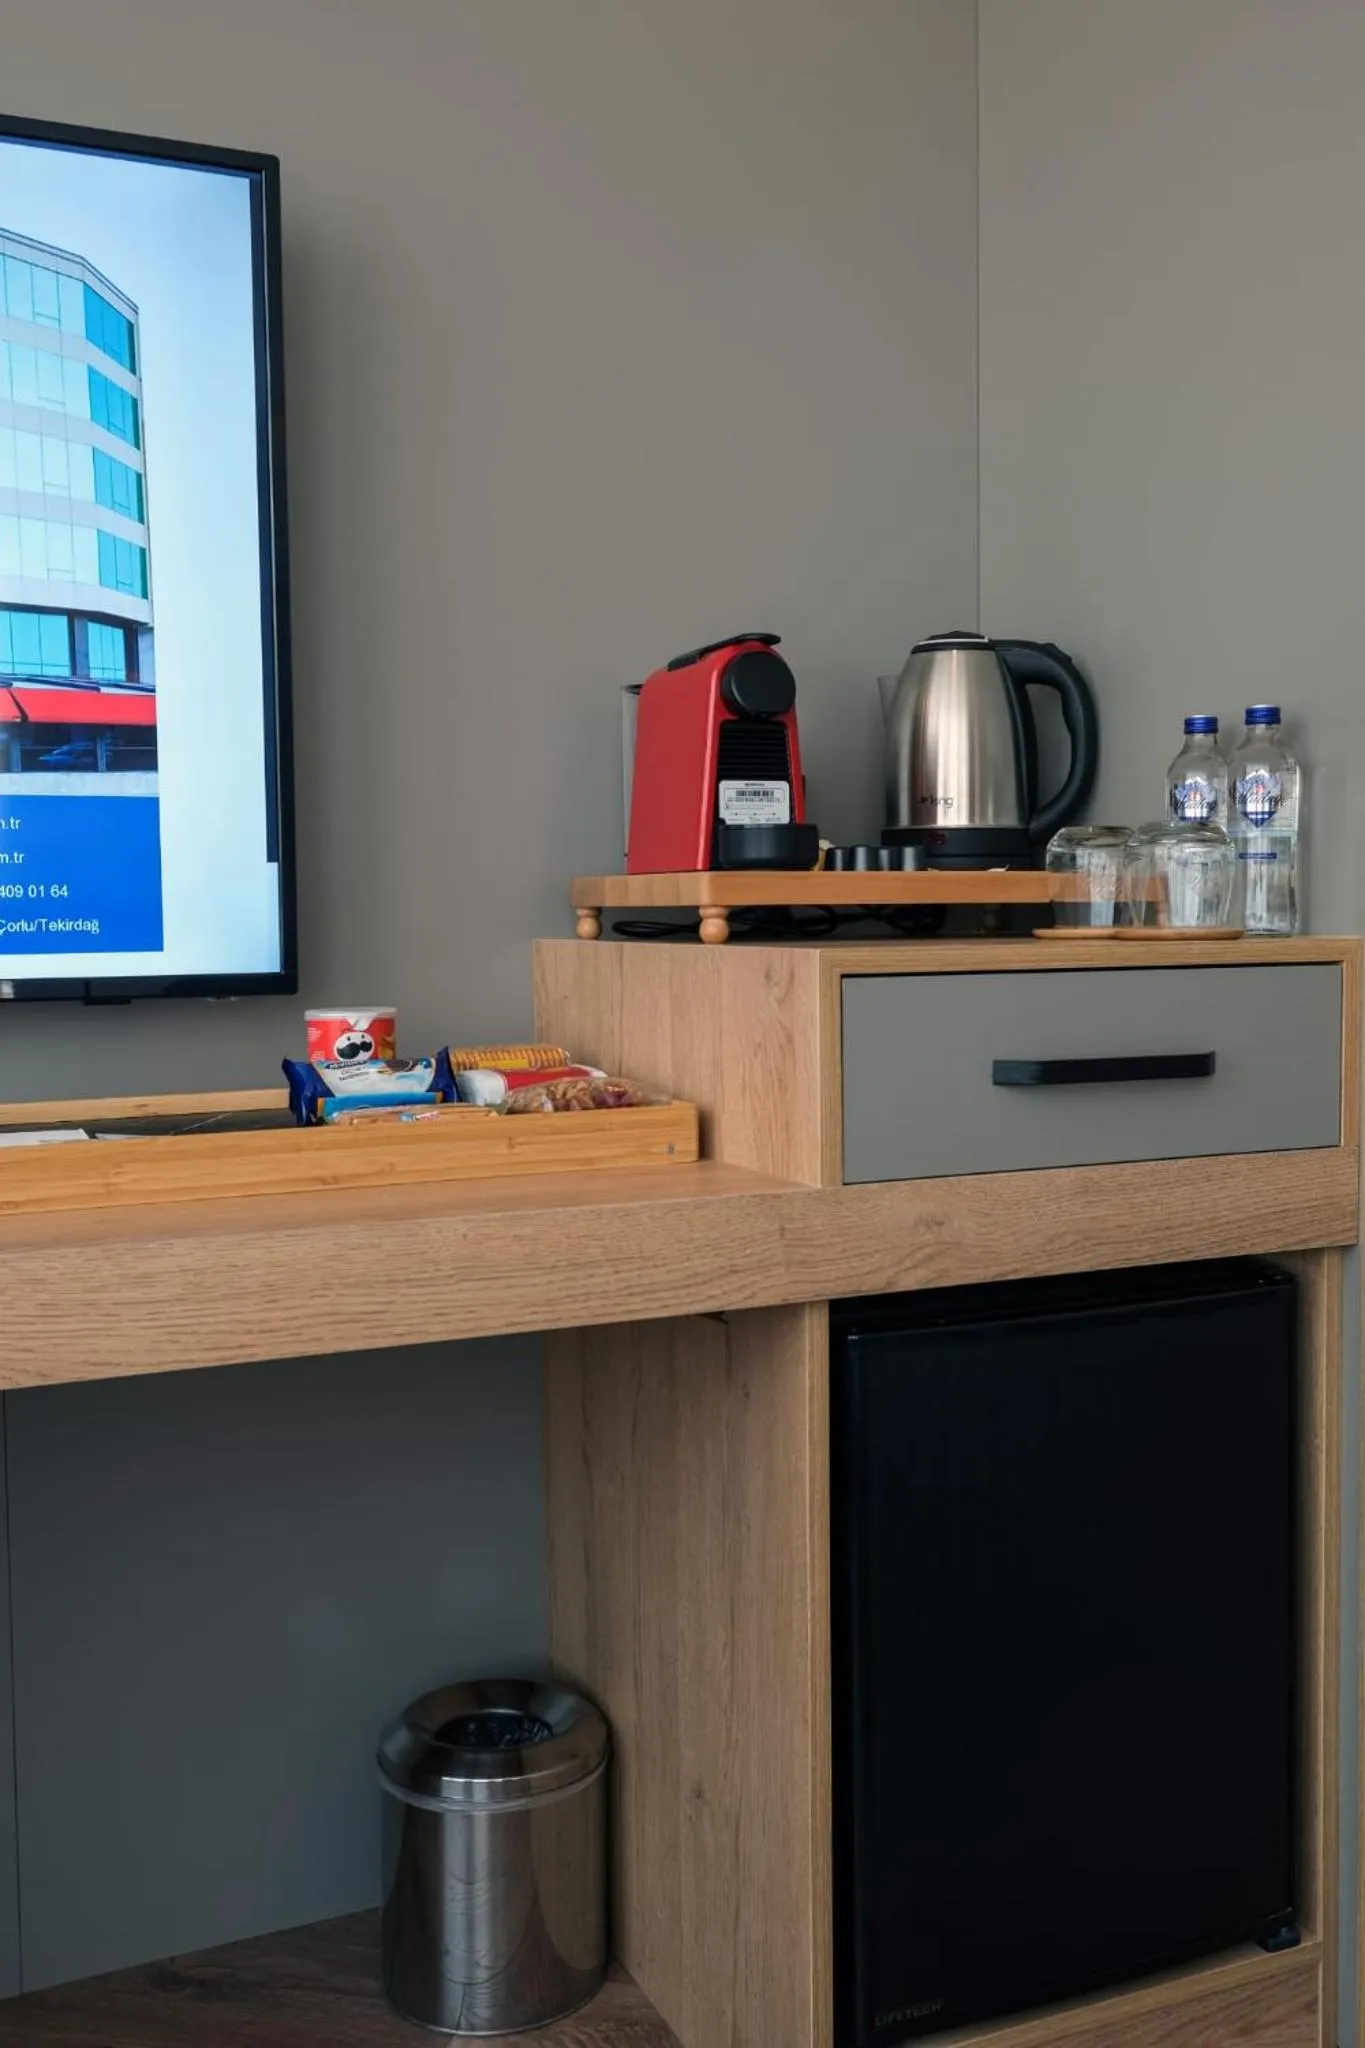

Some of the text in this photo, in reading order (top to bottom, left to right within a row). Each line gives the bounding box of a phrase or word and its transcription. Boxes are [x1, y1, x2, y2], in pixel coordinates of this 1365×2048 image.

[0, 884, 68, 898] 409 01 64
